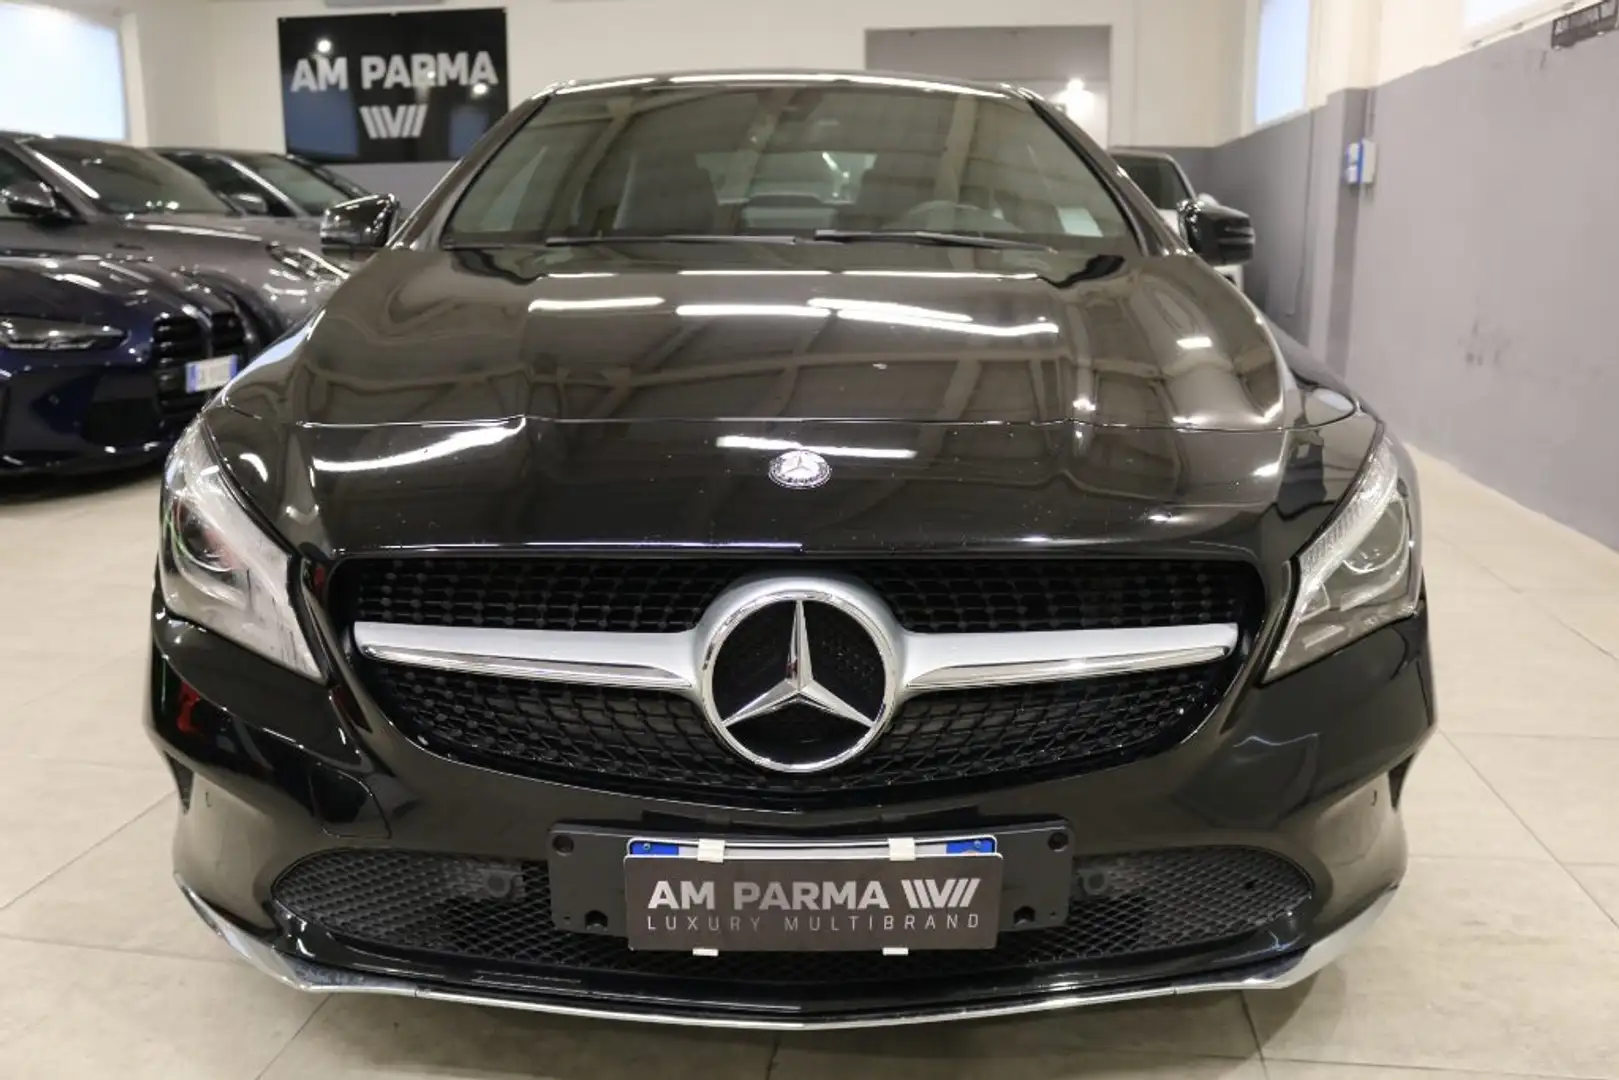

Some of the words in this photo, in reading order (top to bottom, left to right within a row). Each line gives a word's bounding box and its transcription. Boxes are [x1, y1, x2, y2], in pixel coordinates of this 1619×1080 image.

[291, 56, 348, 92] AM
[360, 51, 499, 90] PARMA
[647, 880, 715, 910] AM
[733, 880, 889, 911] PARMA
[647, 914, 761, 931] LUXURY
[784, 914, 980, 931] MULTIBRAND
